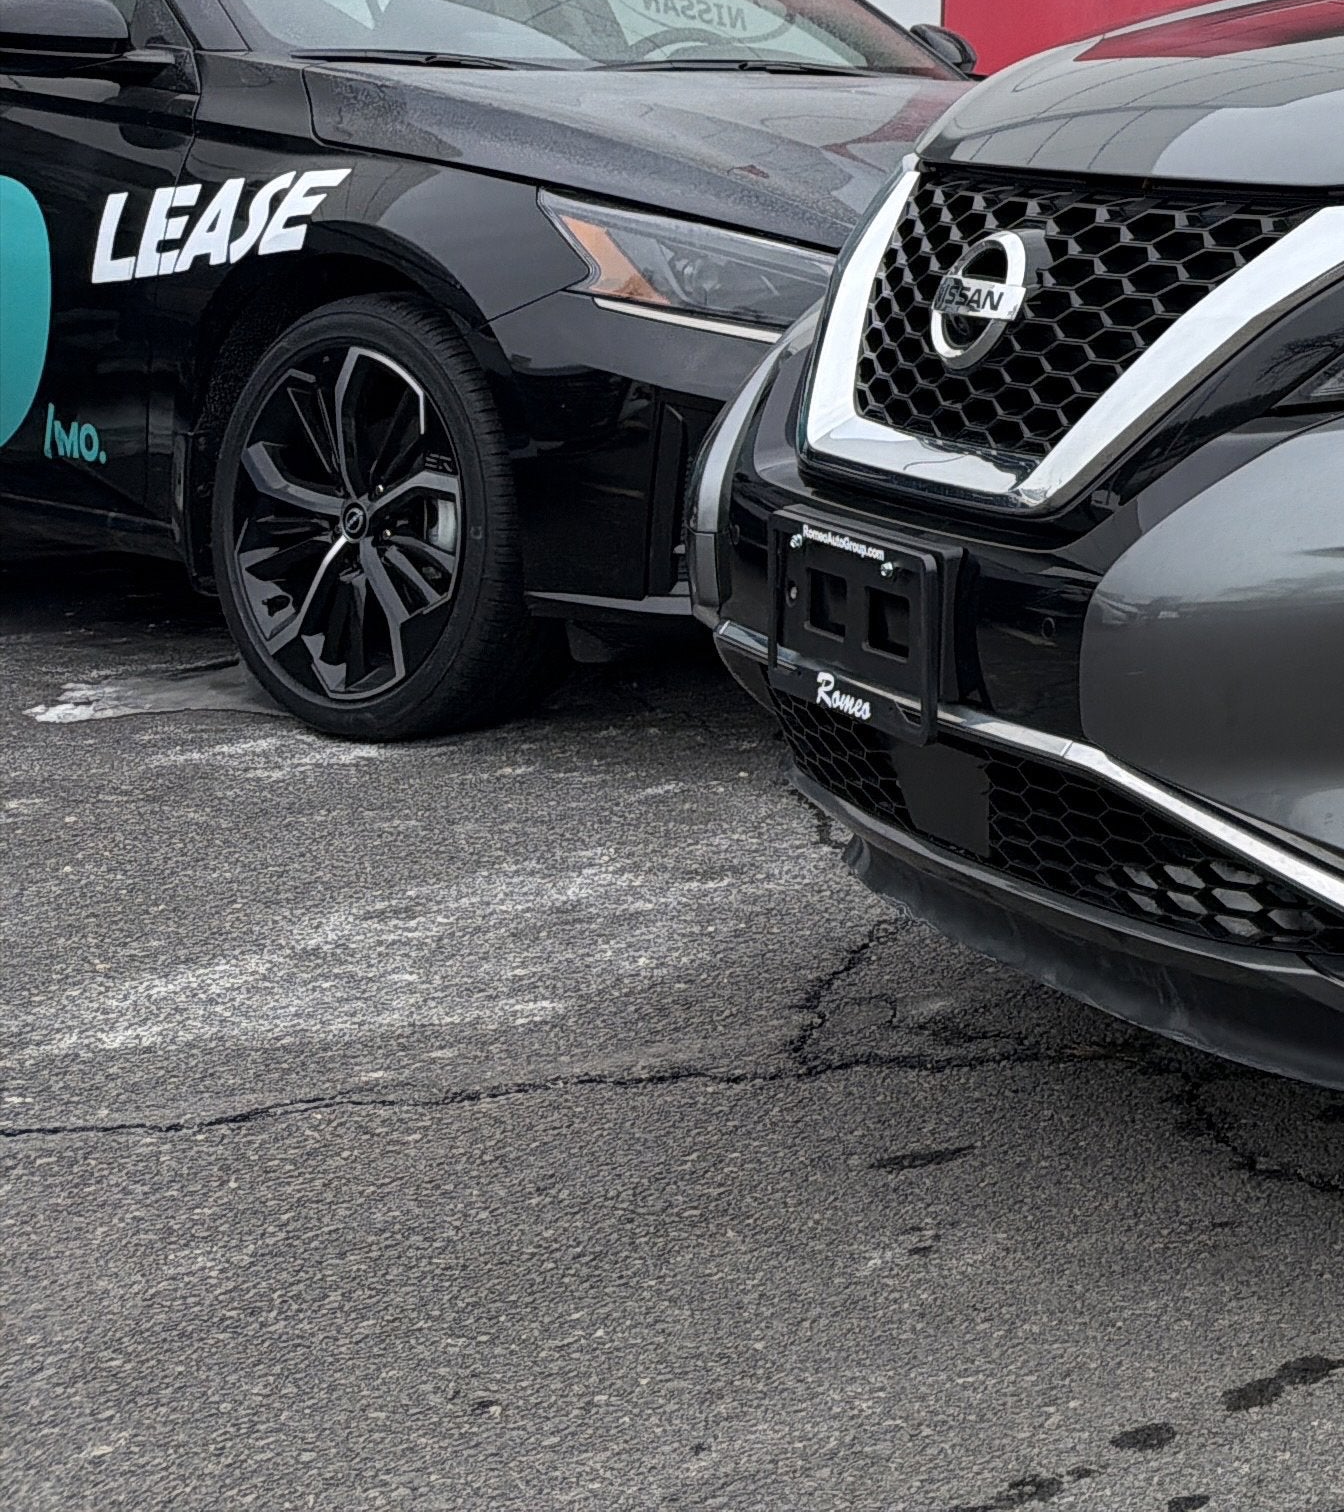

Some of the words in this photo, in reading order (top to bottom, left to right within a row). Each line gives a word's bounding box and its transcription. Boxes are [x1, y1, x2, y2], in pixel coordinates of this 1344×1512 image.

[91, 168, 352, 284] LEASE
[934, 284, 1005, 312] NISSAN
[802, 524, 885, 561] RomeoAutoGroup.com
[816, 671, 872, 720] Romeo
